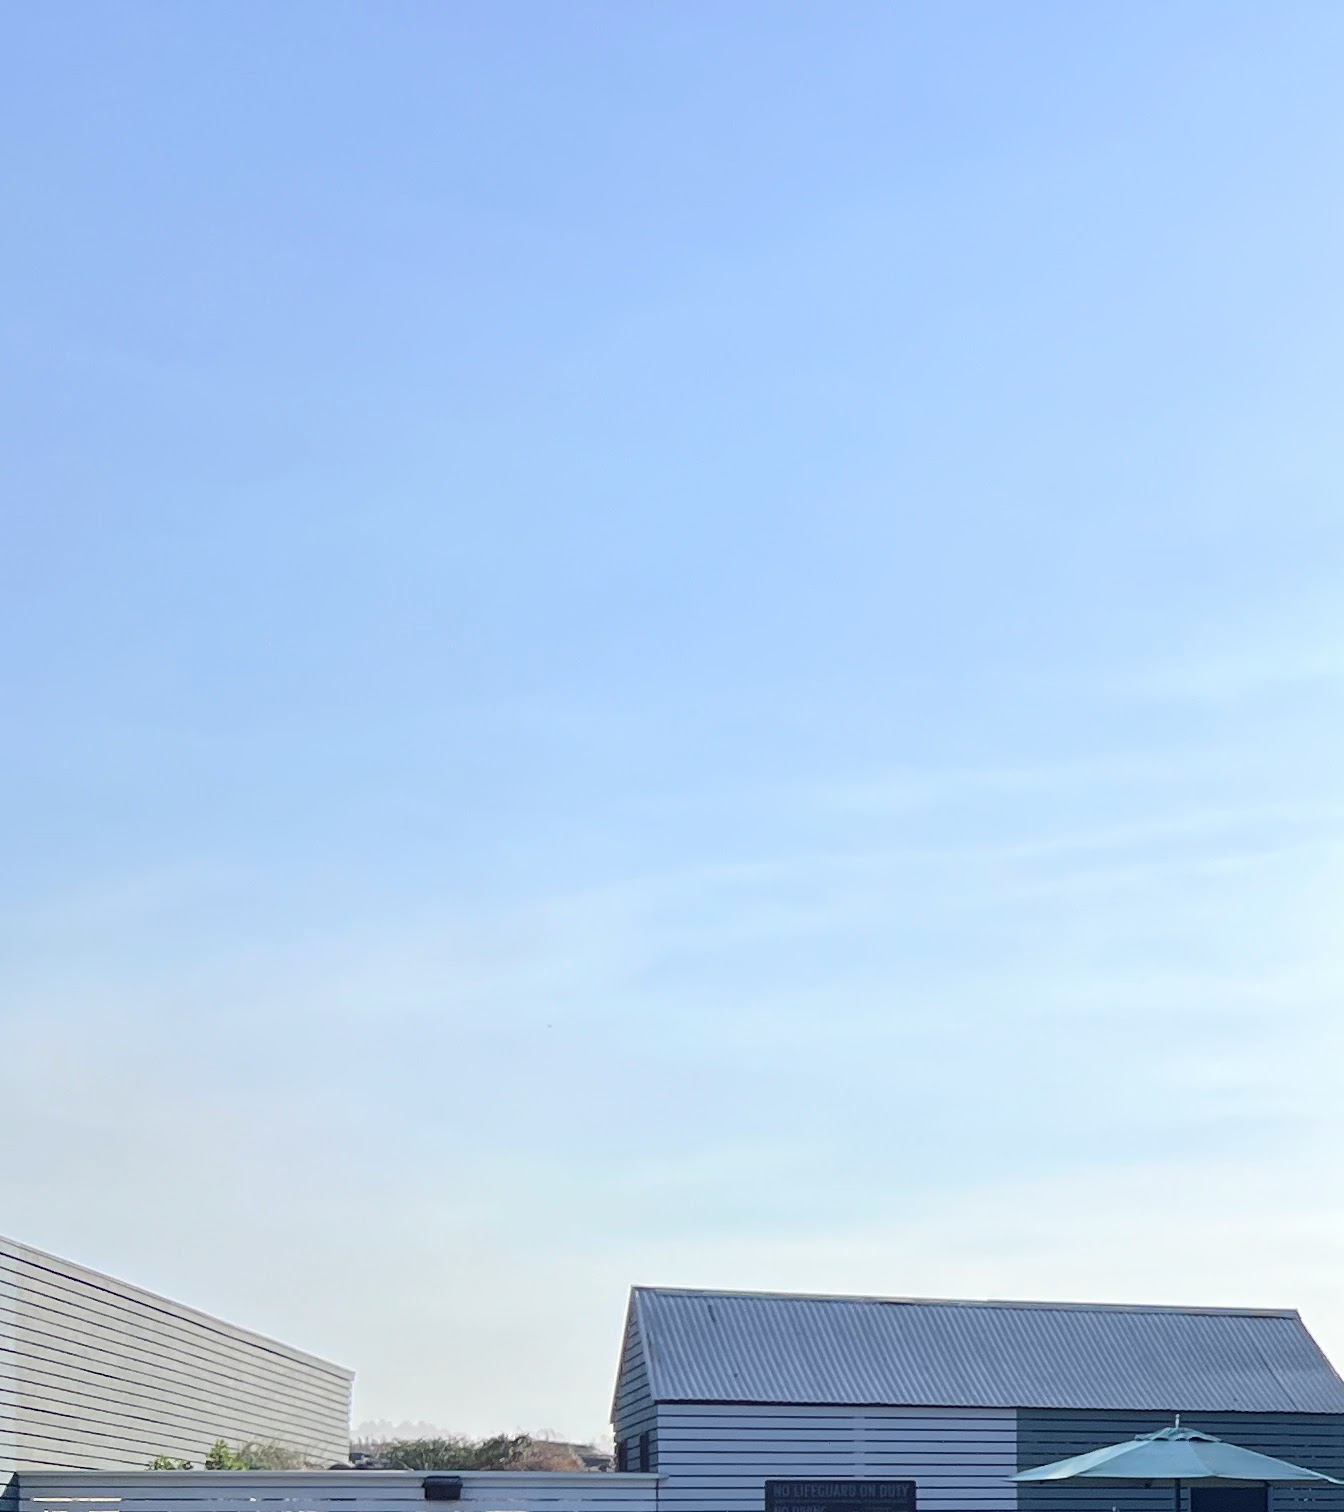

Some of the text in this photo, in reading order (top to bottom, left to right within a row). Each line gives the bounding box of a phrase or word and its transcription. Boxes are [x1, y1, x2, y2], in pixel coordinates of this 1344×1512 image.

[773, 1484, 908, 1497] NO LIFEGUARD ON DUTY
